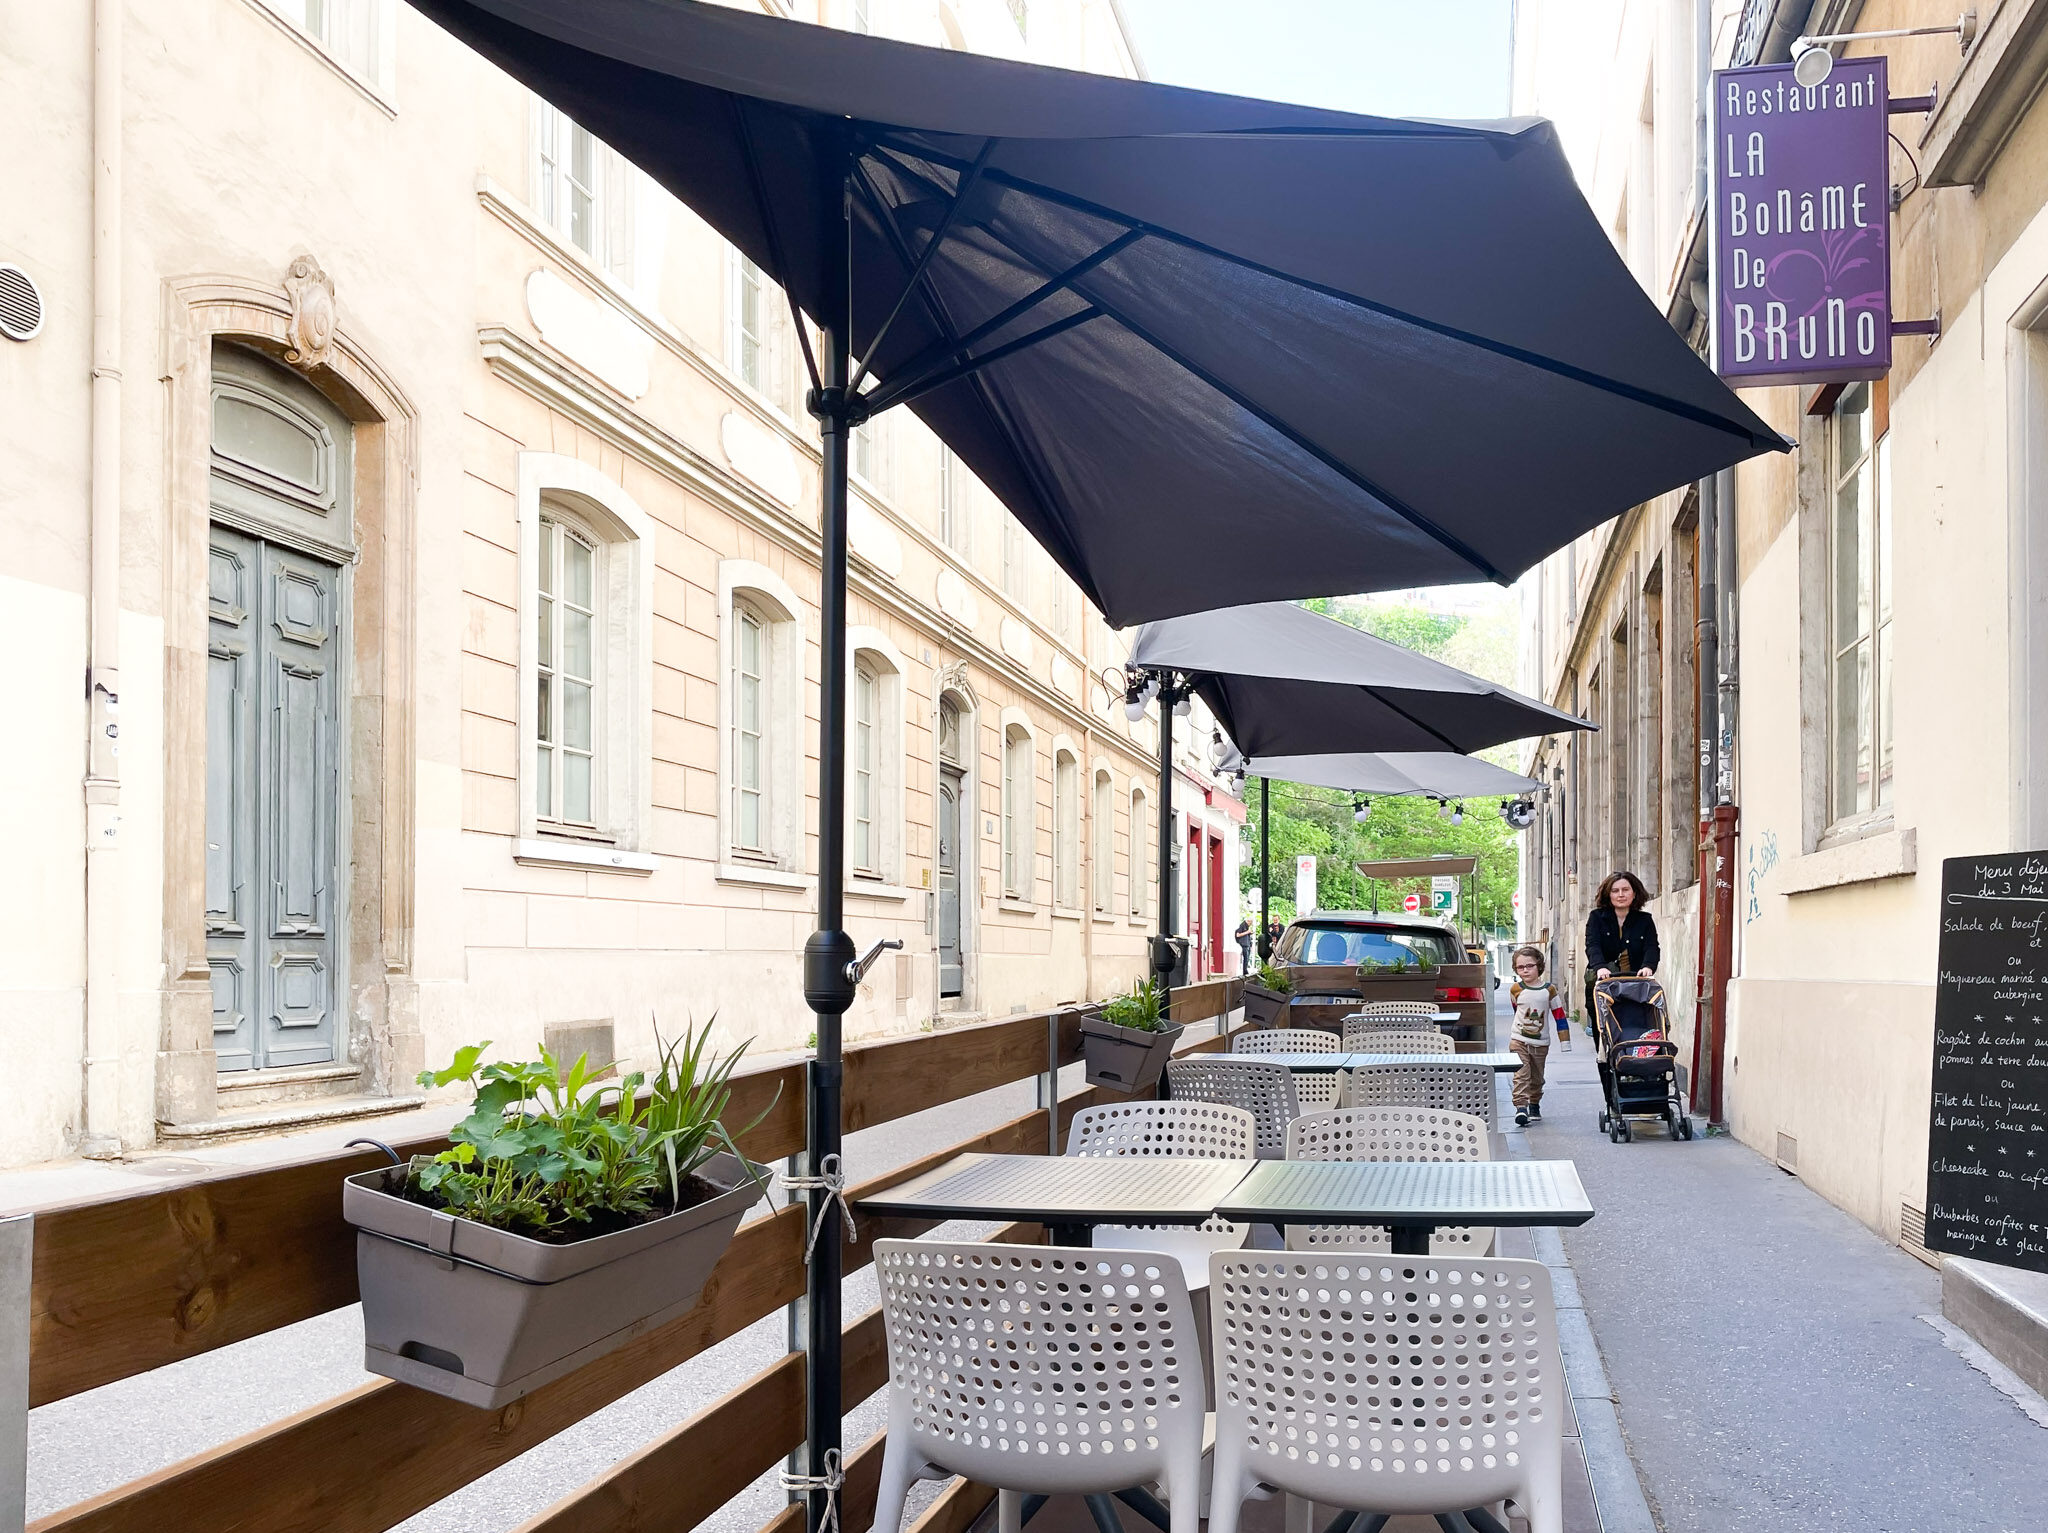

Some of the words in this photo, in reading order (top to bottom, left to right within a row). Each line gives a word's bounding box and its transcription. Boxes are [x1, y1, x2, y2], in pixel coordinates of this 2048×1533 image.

[1727, 73, 1875, 116] Restaurant
[1727, 131, 1765, 178] LA
[1733, 248, 1766, 290] De
[1974, 864, 2013, 880] Menu
[1978, 883, 1996, 897] du
[2001, 882, 2011, 894] 3
[2020, 881, 2044, 894] Mai
[1434, 892, 1445, 907] P
[1944, 917, 1984, 933] Salade
[1989, 917, 2004, 931] de
[2029, 937, 2043, 948] et
[1939, 970, 1996, 992] Maquereau
[2000, 969, 2035, 984] mariné
[1993, 987, 2044, 1007] aubergine
[1936, 1028, 1972, 1054] Ragoût
[1977, 1031, 1992, 1045] de
[1994, 1031, 2026, 1045] cochon
[1939, 1054, 1974, 1069] pommes
[1980, 1051, 1994, 1065] de
[1997, 1056, 2022, 1067] terre
[1934, 1092, 1959, 1107] Filet
[1961, 1093, 1975, 1107] de
[1934, 1112, 1947, 1127] de
[1994, 1119, 2026, 1133] sauce
[2030, 1123, 2045, 1132] au
[1997, 1169, 2015, 1180] au
[1932, 1203, 1980, 1224] Rhubarbes
[1984, 1214, 2024, 1236] confites
[1946, 1229, 1987, 1250] meringue
[1995, 1237, 2009, 1247] et
[2015, 1237, 2046, 1256] glace
